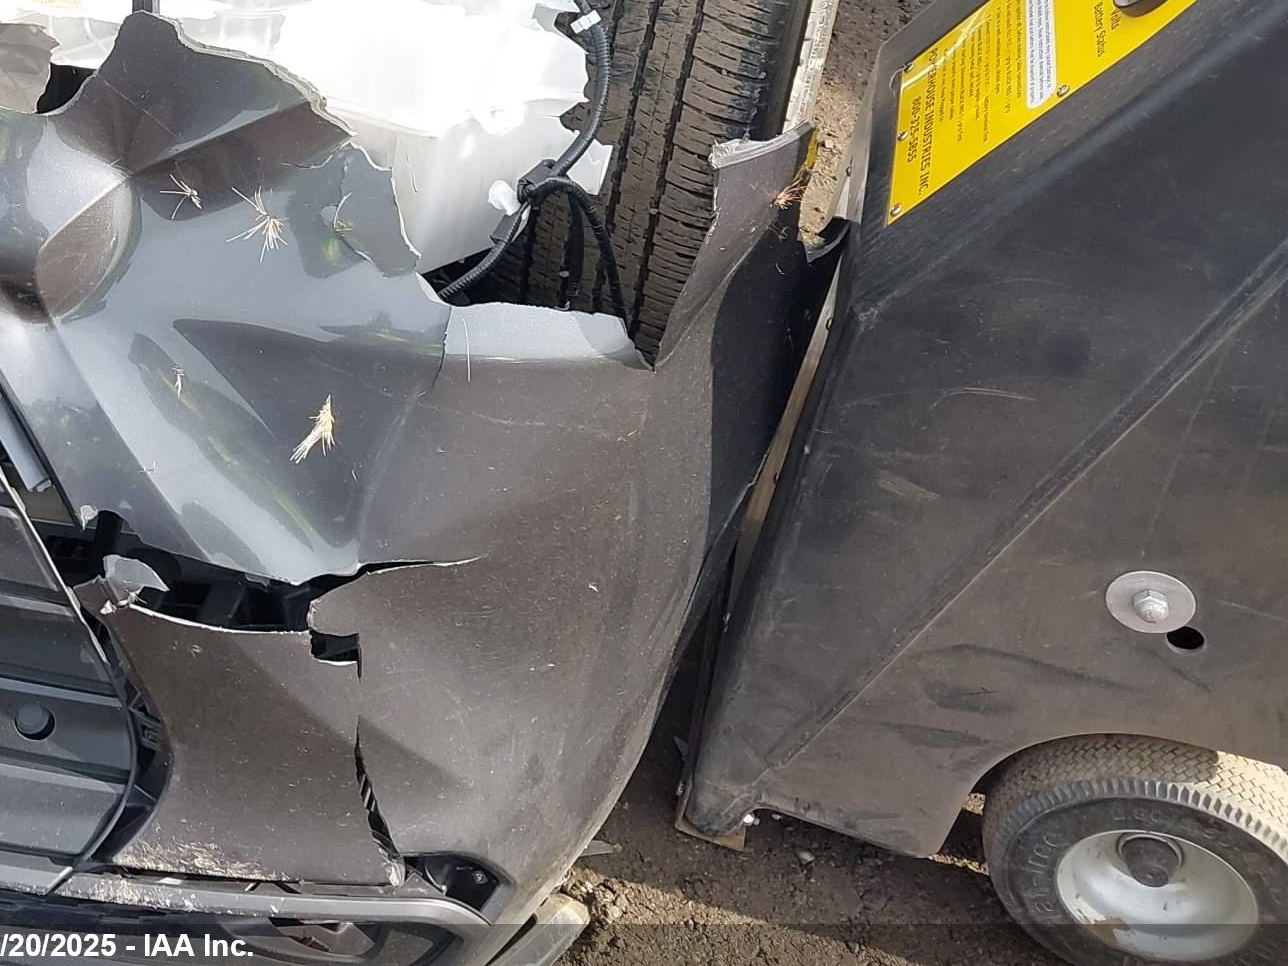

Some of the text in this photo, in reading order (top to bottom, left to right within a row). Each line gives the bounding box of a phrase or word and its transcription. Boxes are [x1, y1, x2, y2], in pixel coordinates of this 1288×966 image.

[1093, 1, 1107, 57] Battery Status
[907, 96, 922, 163] 800-325-5855
[920, 110, 935, 172] INDUSTRIES
